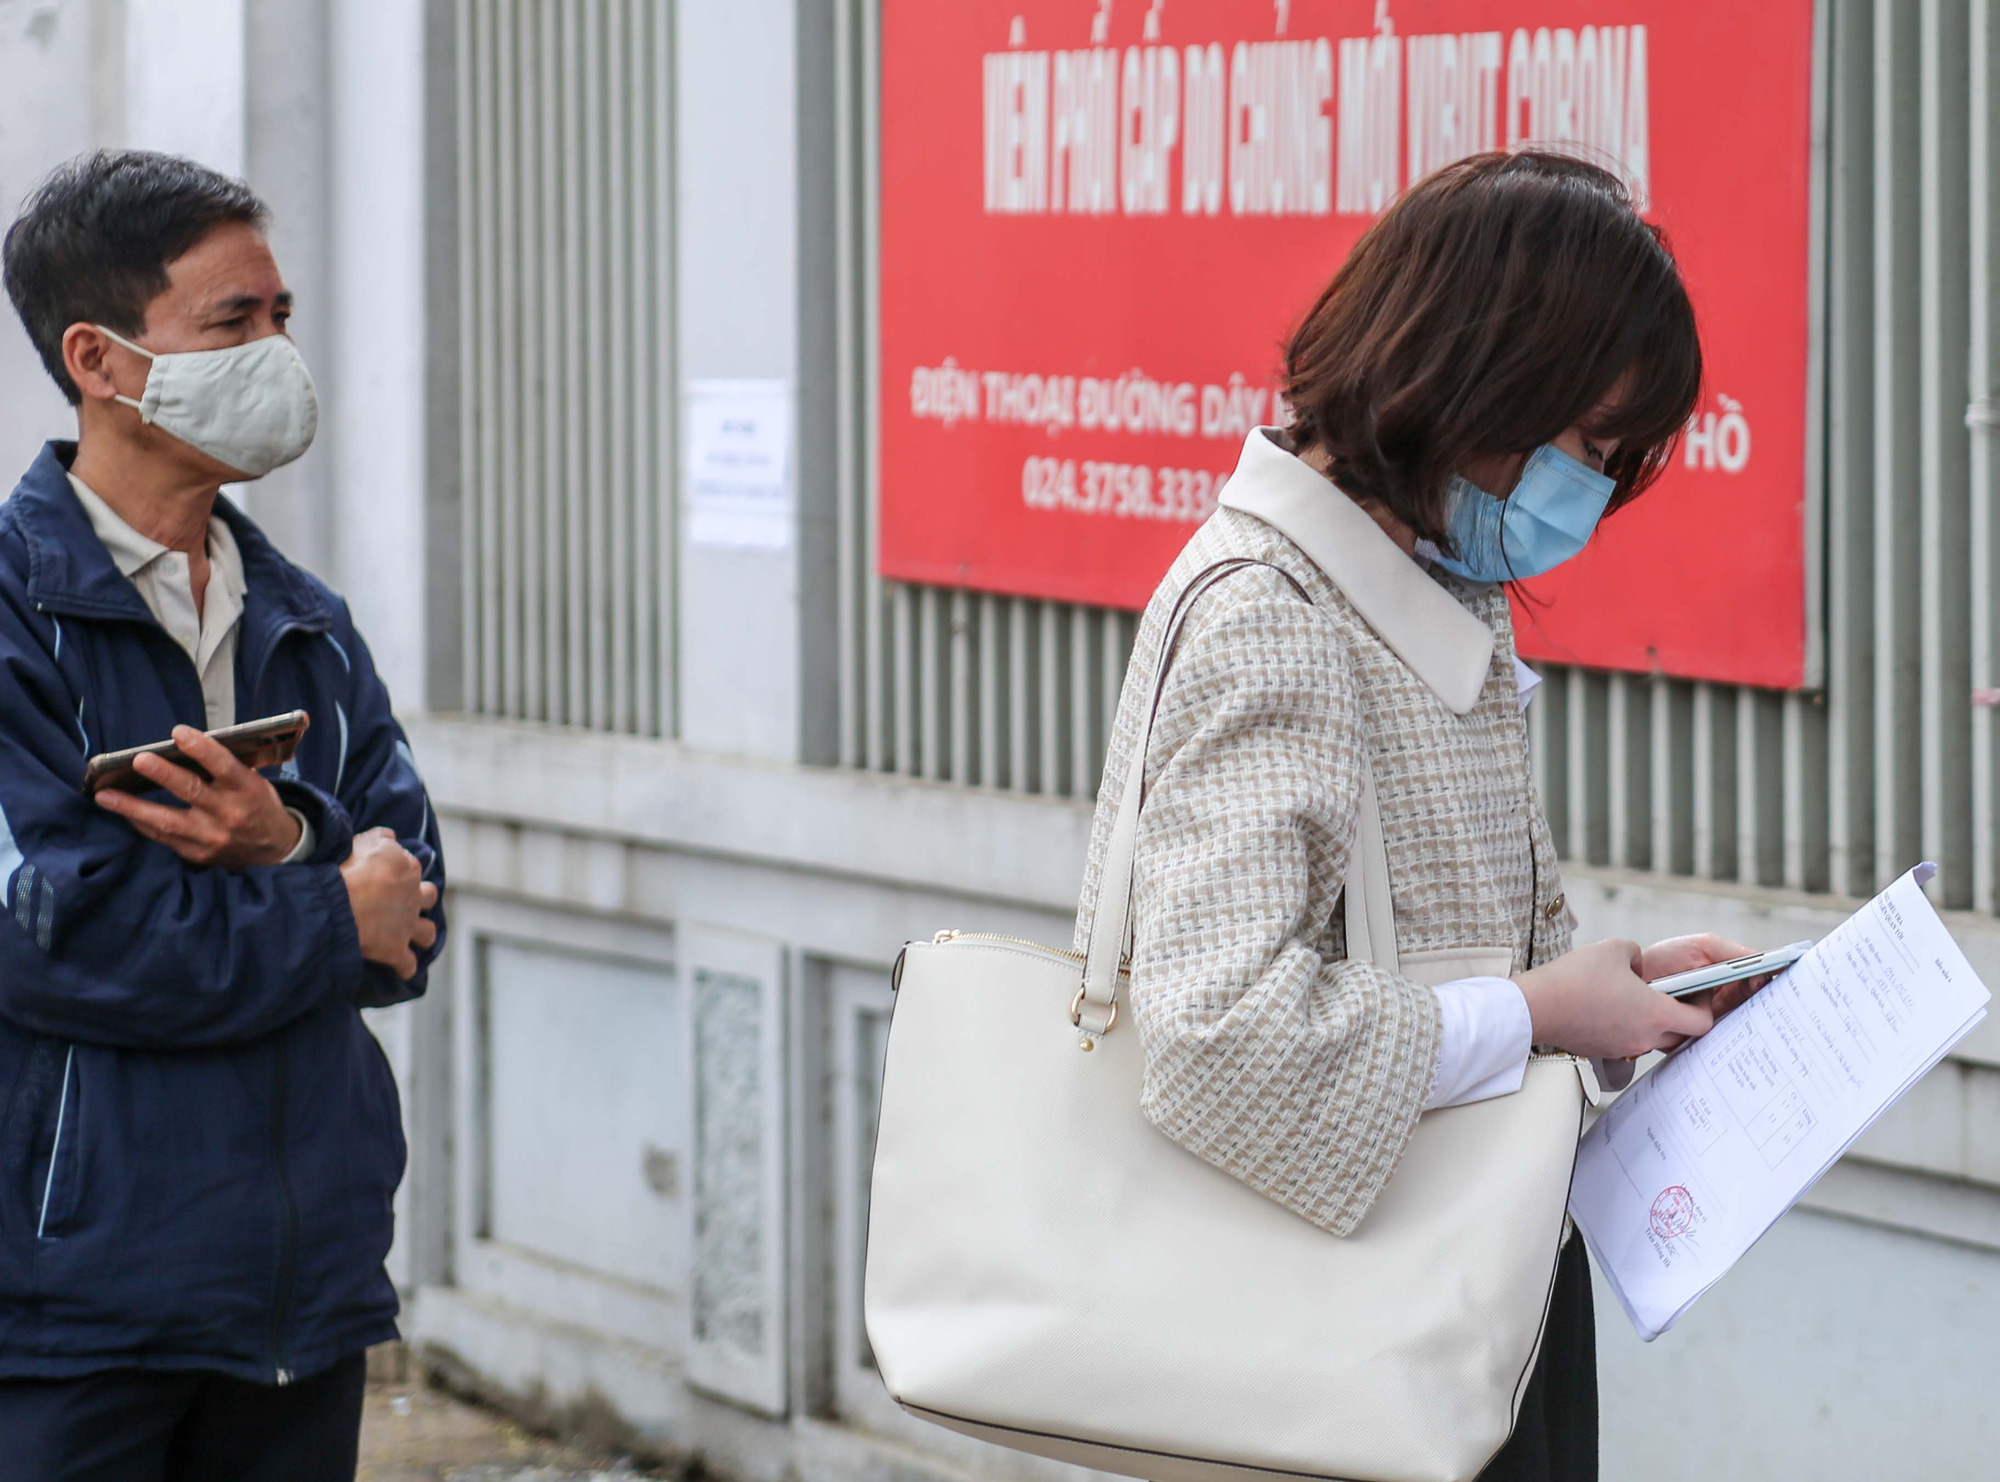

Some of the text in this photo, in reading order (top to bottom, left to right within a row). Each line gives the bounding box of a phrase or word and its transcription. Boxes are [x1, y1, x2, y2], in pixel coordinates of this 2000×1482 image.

[1183, 44, 1226, 216] DO
[1507, 24, 1649, 214] CORONA
[911, 355, 980, 430] ĐIỆN
[983, 370, 1075, 438] THOẠI
[1078, 366, 1196, 437] ĐƯỜNG
[1200, 371, 1267, 440] DÂY
[1684, 393, 1751, 475] HỒ
